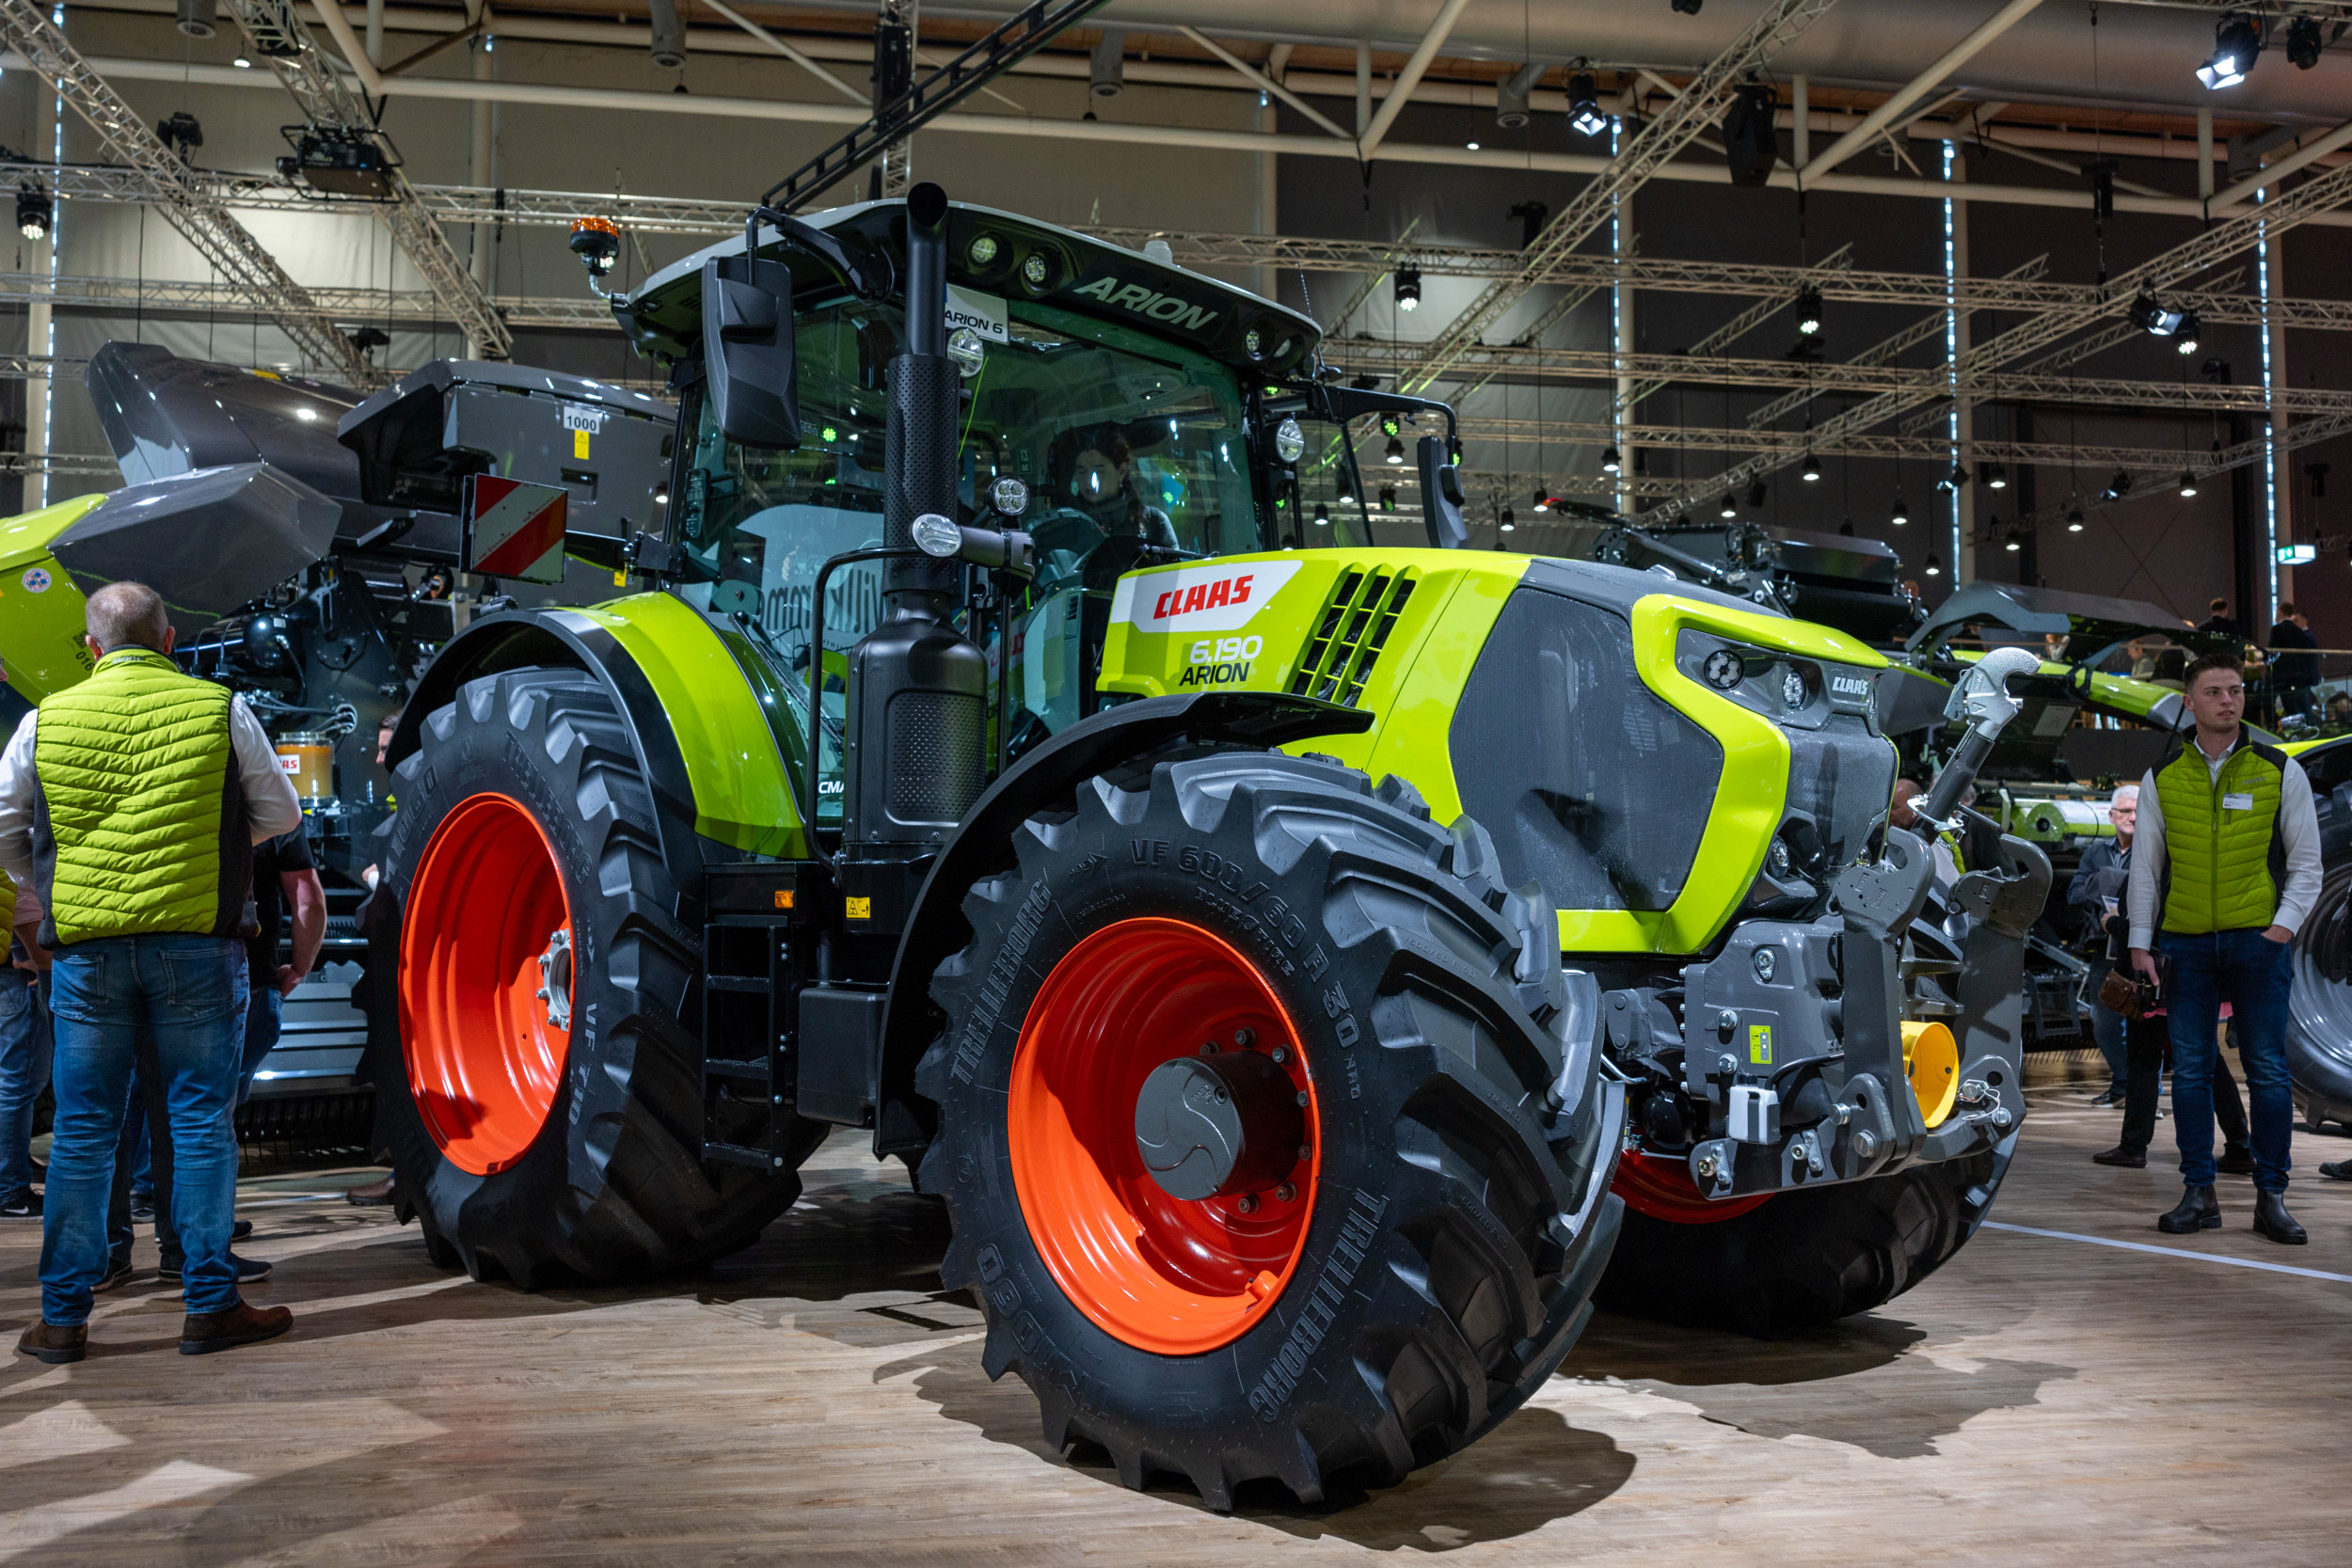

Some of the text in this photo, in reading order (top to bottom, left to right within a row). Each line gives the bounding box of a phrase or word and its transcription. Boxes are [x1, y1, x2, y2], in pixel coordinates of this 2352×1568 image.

[945, 309, 1004, 334] ARION 6
[1073, 277, 1218, 330] ARION
[566, 415, 596, 432] 1000
[1152, 574, 1254, 620] CLAAS
[1189, 635, 1263, 664] 6.190
[1179, 662, 1250, 686] ARION
[1832, 676, 1868, 695] CLAAS
[279, 759, 297, 769] AS
[502, 729, 593, 885] TRELLEBORG
[1129, 838, 1170, 866] VF
[1177, 844, 1308, 949] 600/60
[1302, 942, 1329, 984] R
[1322, 980, 1360, 1049] 30
[949, 879, 1052, 1085] TRELLEBORG
[568, 1002, 597, 1126] VF 710
[1248, 1187, 1391, 1424] TRELLEBORG
